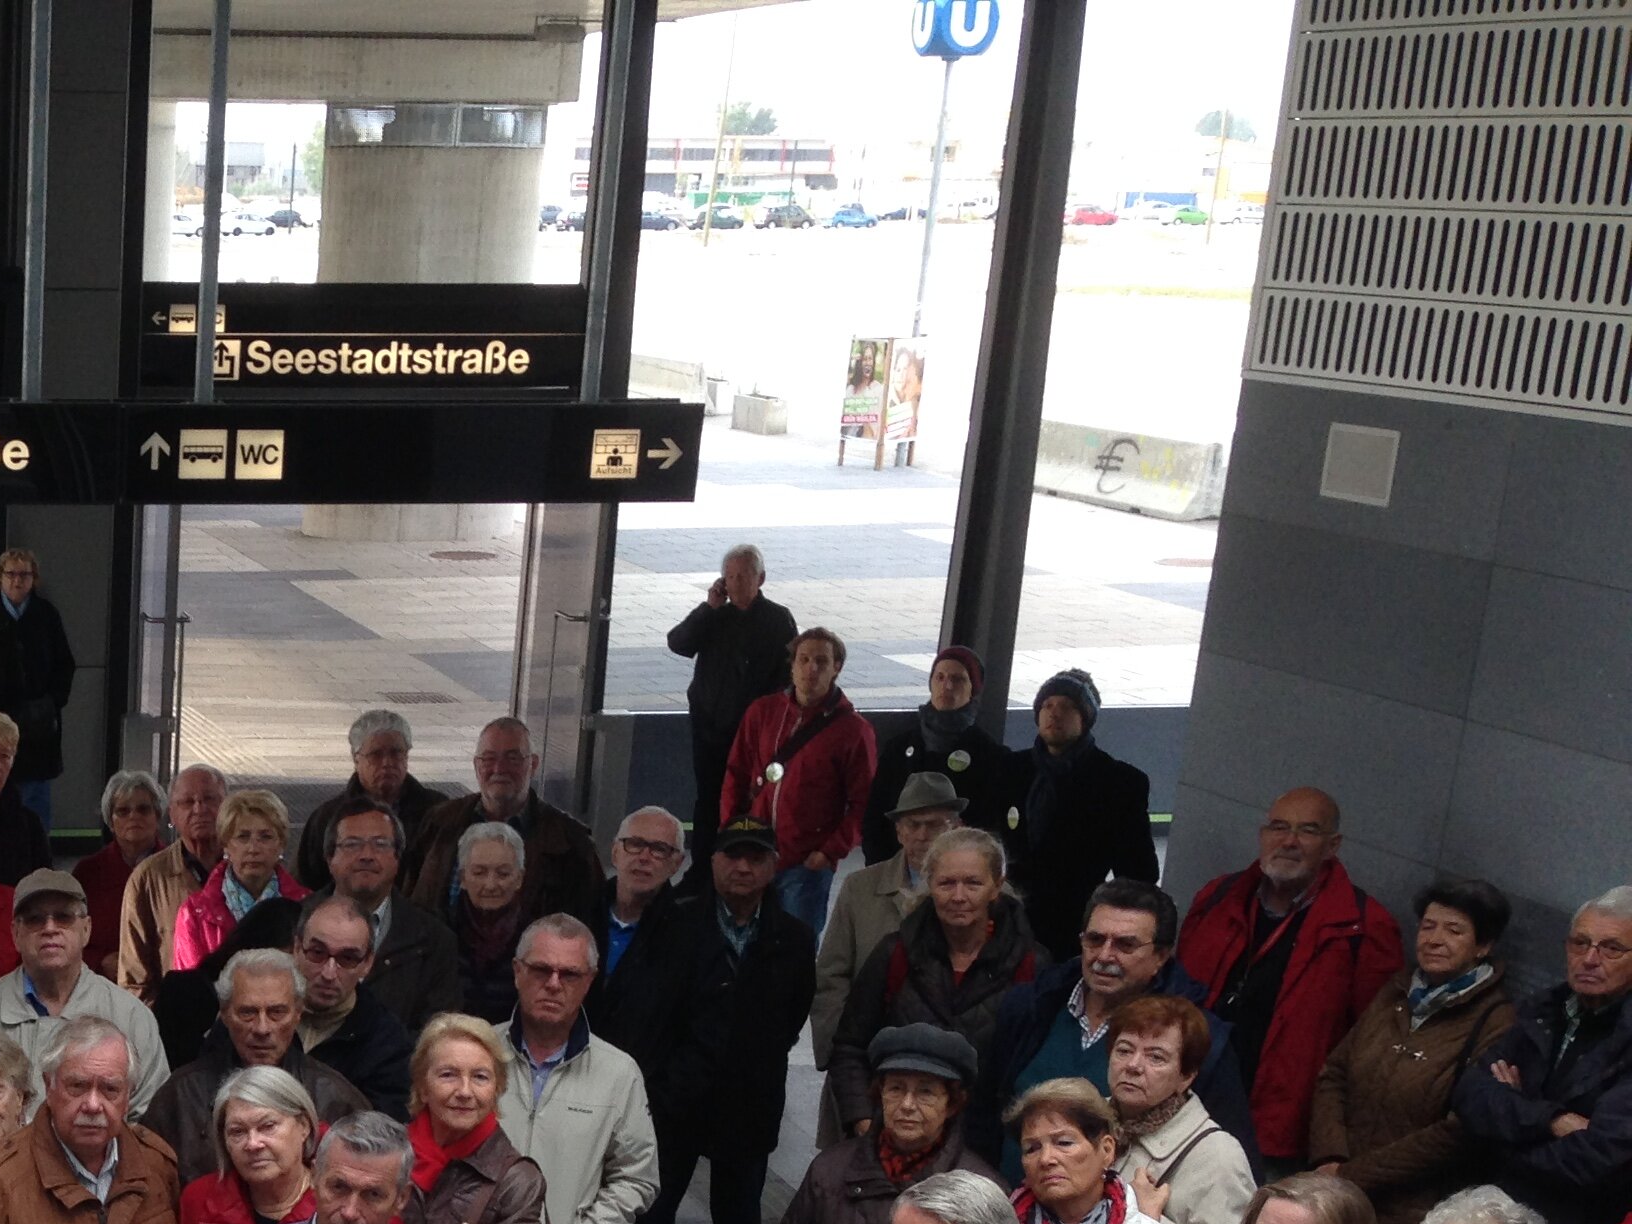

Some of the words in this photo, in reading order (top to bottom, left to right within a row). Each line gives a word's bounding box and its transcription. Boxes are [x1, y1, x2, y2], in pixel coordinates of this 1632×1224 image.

[950, 0, 992, 48] U
[245, 340, 531, 376] Seestadtstraße
[240, 443, 280, 465] WC
[595, 467, 633, 475] Aufsicht
